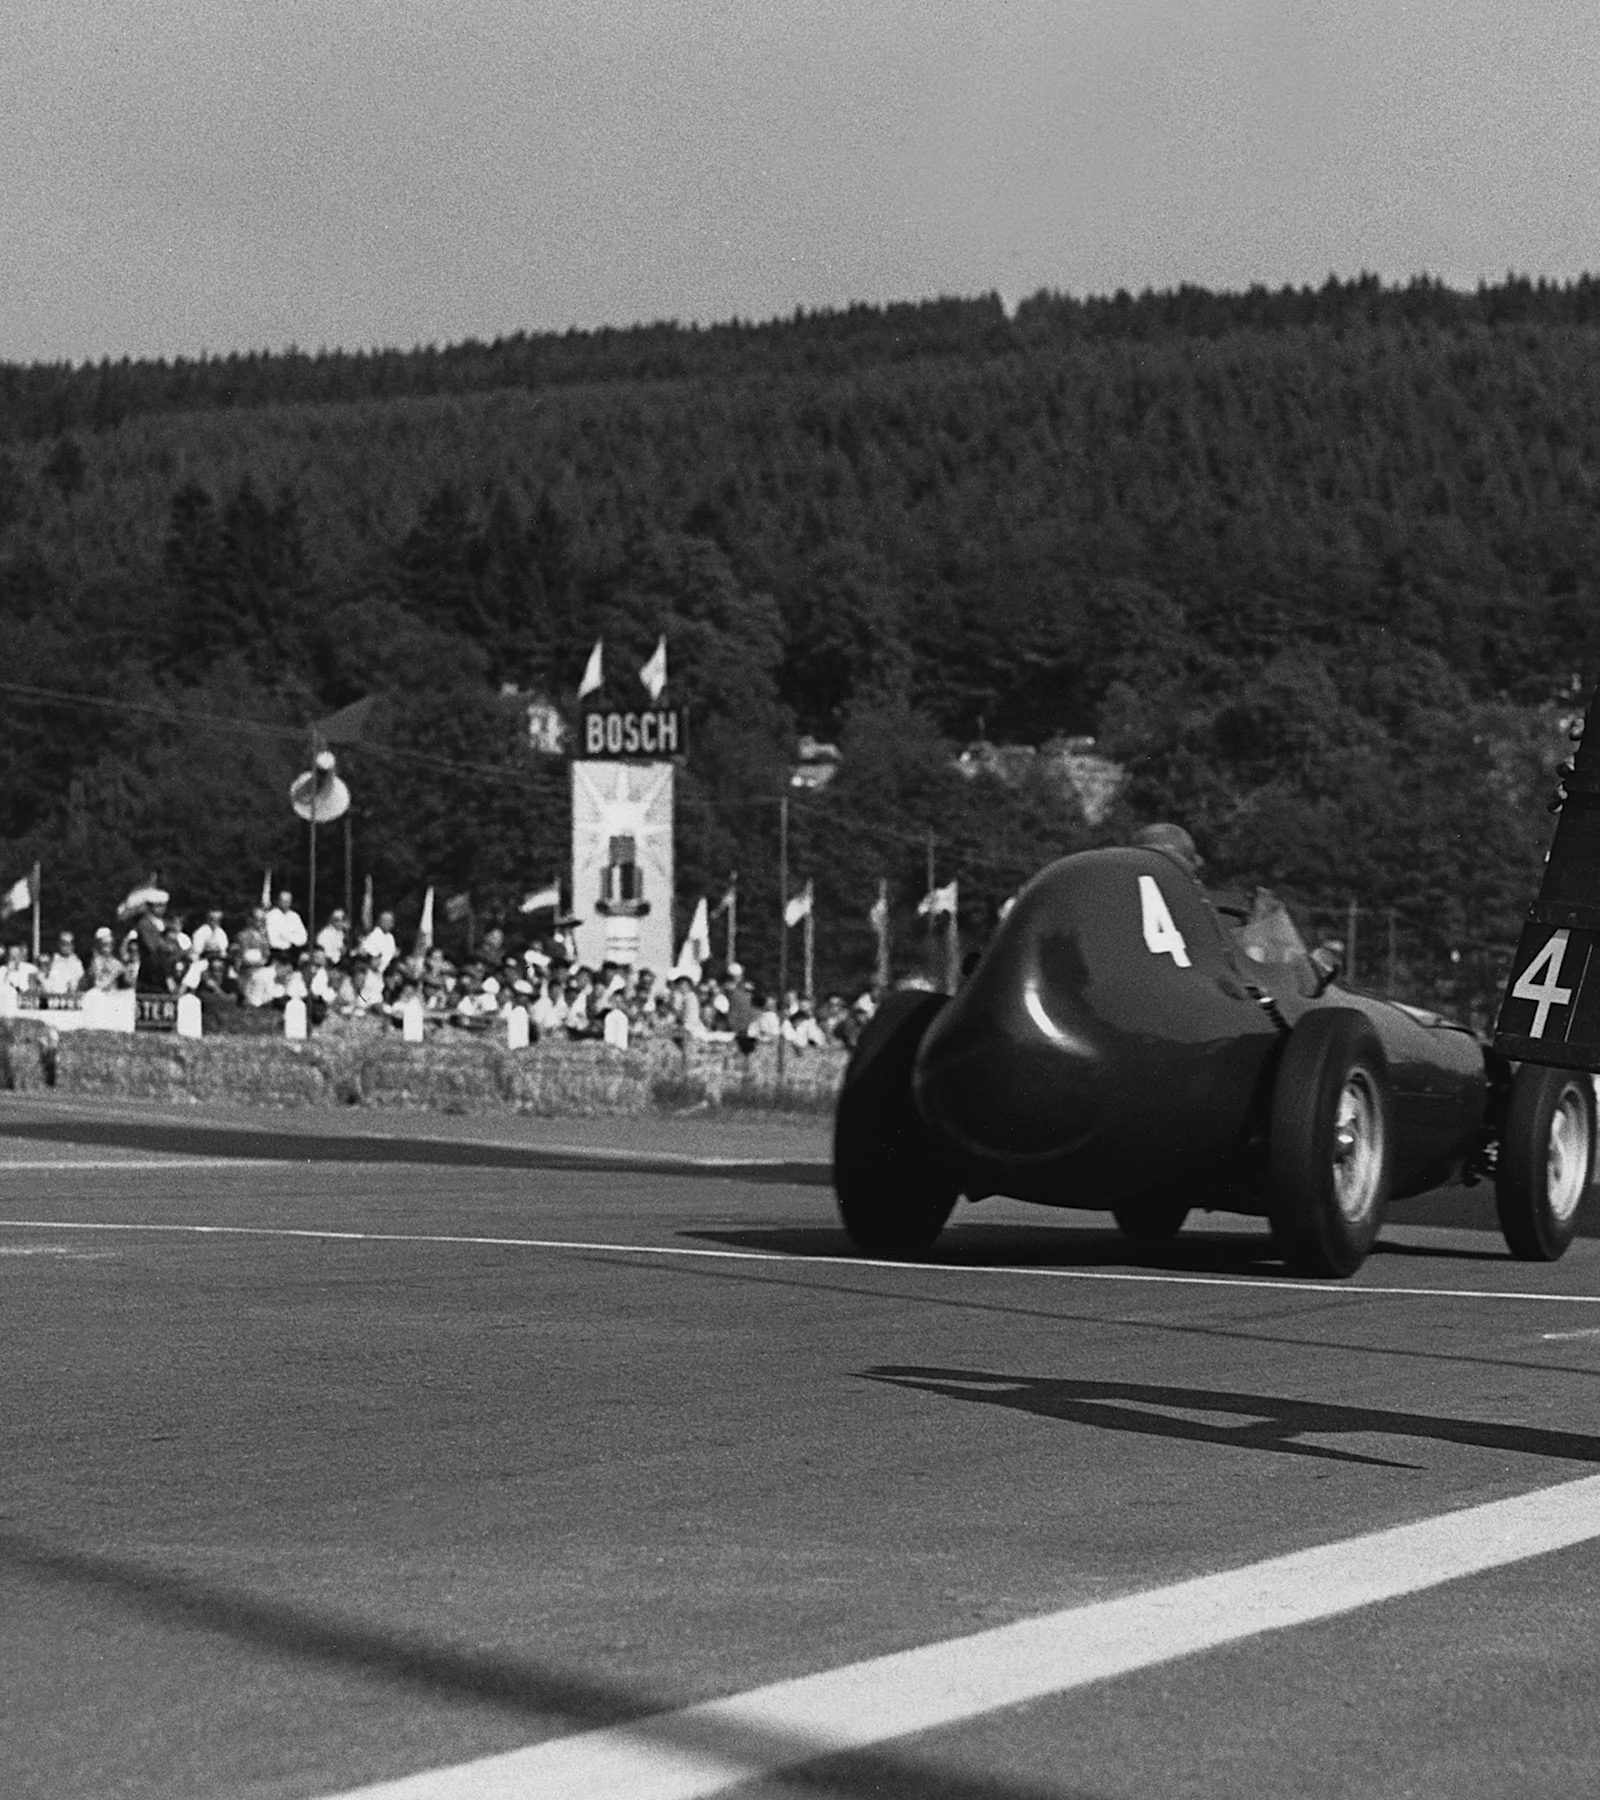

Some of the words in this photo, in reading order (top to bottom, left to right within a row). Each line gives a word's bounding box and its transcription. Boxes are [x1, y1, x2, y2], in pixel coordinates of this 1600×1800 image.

[586, 711, 677, 753] BOSCH
[1138, 876, 1192, 968] 4
[1511, 929, 1572, 1038] 4
